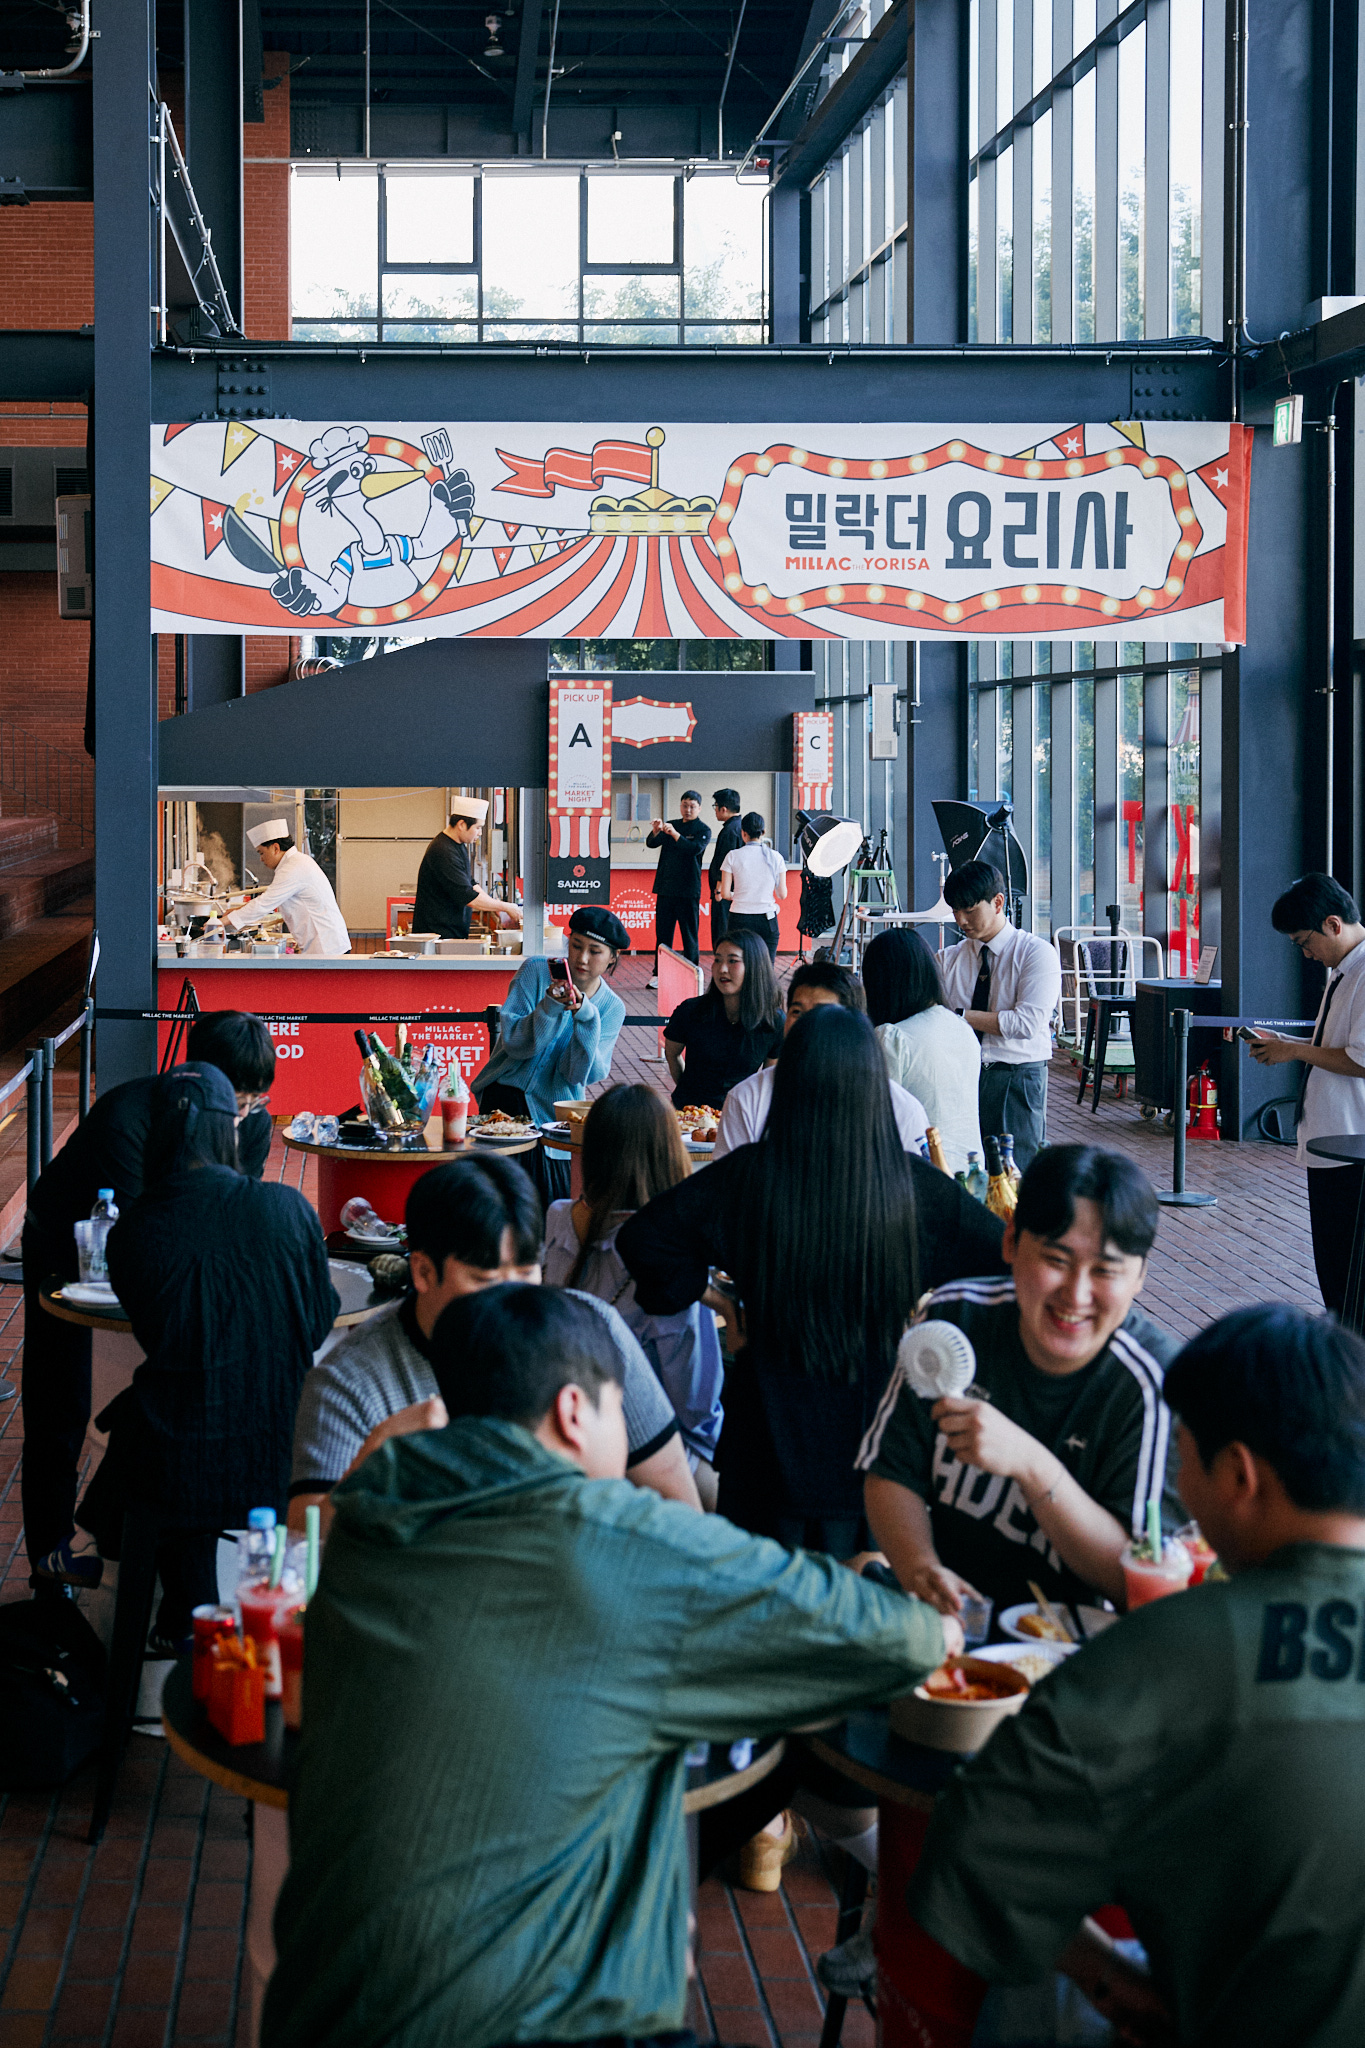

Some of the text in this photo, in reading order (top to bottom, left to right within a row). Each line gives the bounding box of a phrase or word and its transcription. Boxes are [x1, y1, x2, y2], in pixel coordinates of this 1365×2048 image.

[785, 490, 1134, 570] 밀락더 요리사
[785, 556, 852, 571] MILLAC
[864, 557, 930, 571] YORISA
[563, 694, 600, 702] PICK UP
[568, 723, 592, 747] A
[810, 736, 820, 749] C
[557, 880, 601, 889] SANZHO
[424, 1046, 485, 1061] RKET
[1256, 1600, 1365, 1683] BS
